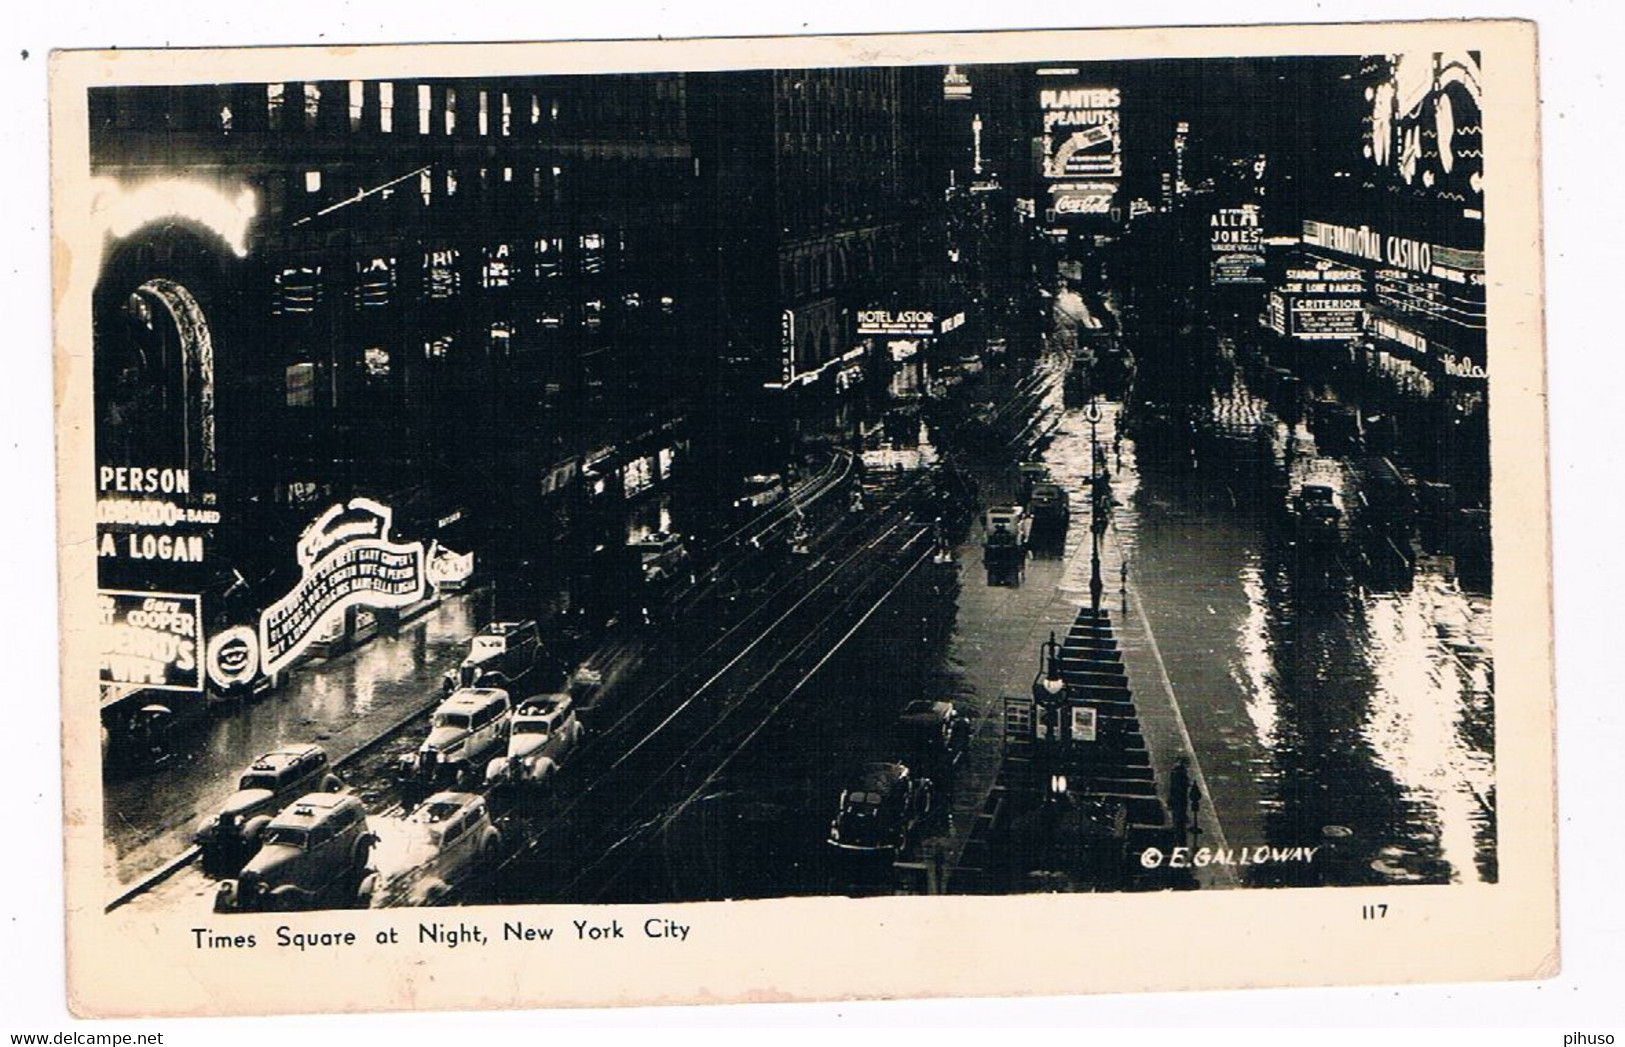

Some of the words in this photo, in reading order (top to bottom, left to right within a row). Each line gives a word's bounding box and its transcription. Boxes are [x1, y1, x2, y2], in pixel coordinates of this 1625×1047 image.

[1040, 89, 1121, 109] PLANTERS
[1049, 110, 1114, 125] PEANUTS
[1210, 230, 1259, 243] JONES
[1387, 236, 1431, 274] CASINO
[1297, 299, 1360, 309] CRITERION
[857, 311, 893, 323] HOTEL
[896, 311, 934, 323] ASTOR
[100, 466, 190, 493] PERSON
[129, 533, 204, 562] LOGAN
[126, 610, 195, 638] COOPER
